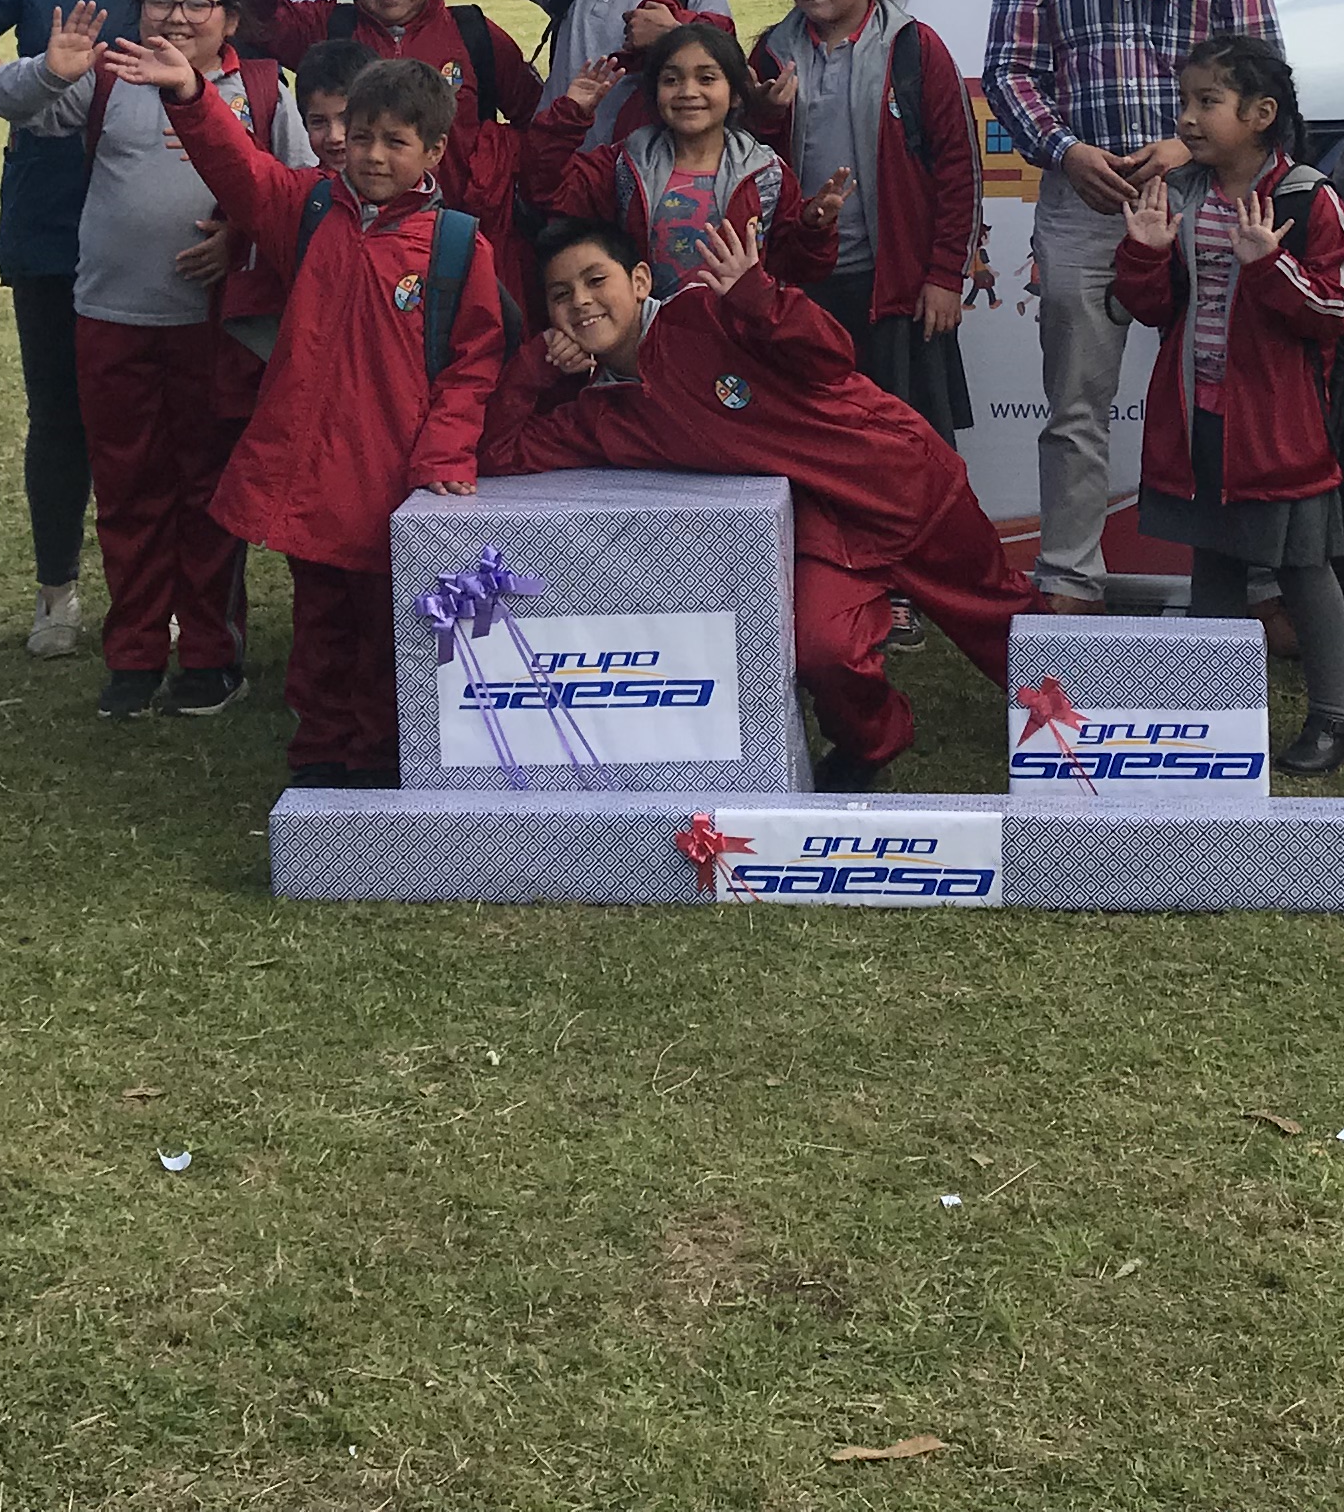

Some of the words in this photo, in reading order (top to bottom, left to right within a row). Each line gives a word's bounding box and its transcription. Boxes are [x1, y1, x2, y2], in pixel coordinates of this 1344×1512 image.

[531, 650, 660, 674] grupo
[458, 679, 715, 710] saesa
[1076, 723, 1210, 745] grupo
[1009, 752, 1265, 780] saesa
[800, 836, 939, 859] grupo
[726, 865, 996, 897] saesa
